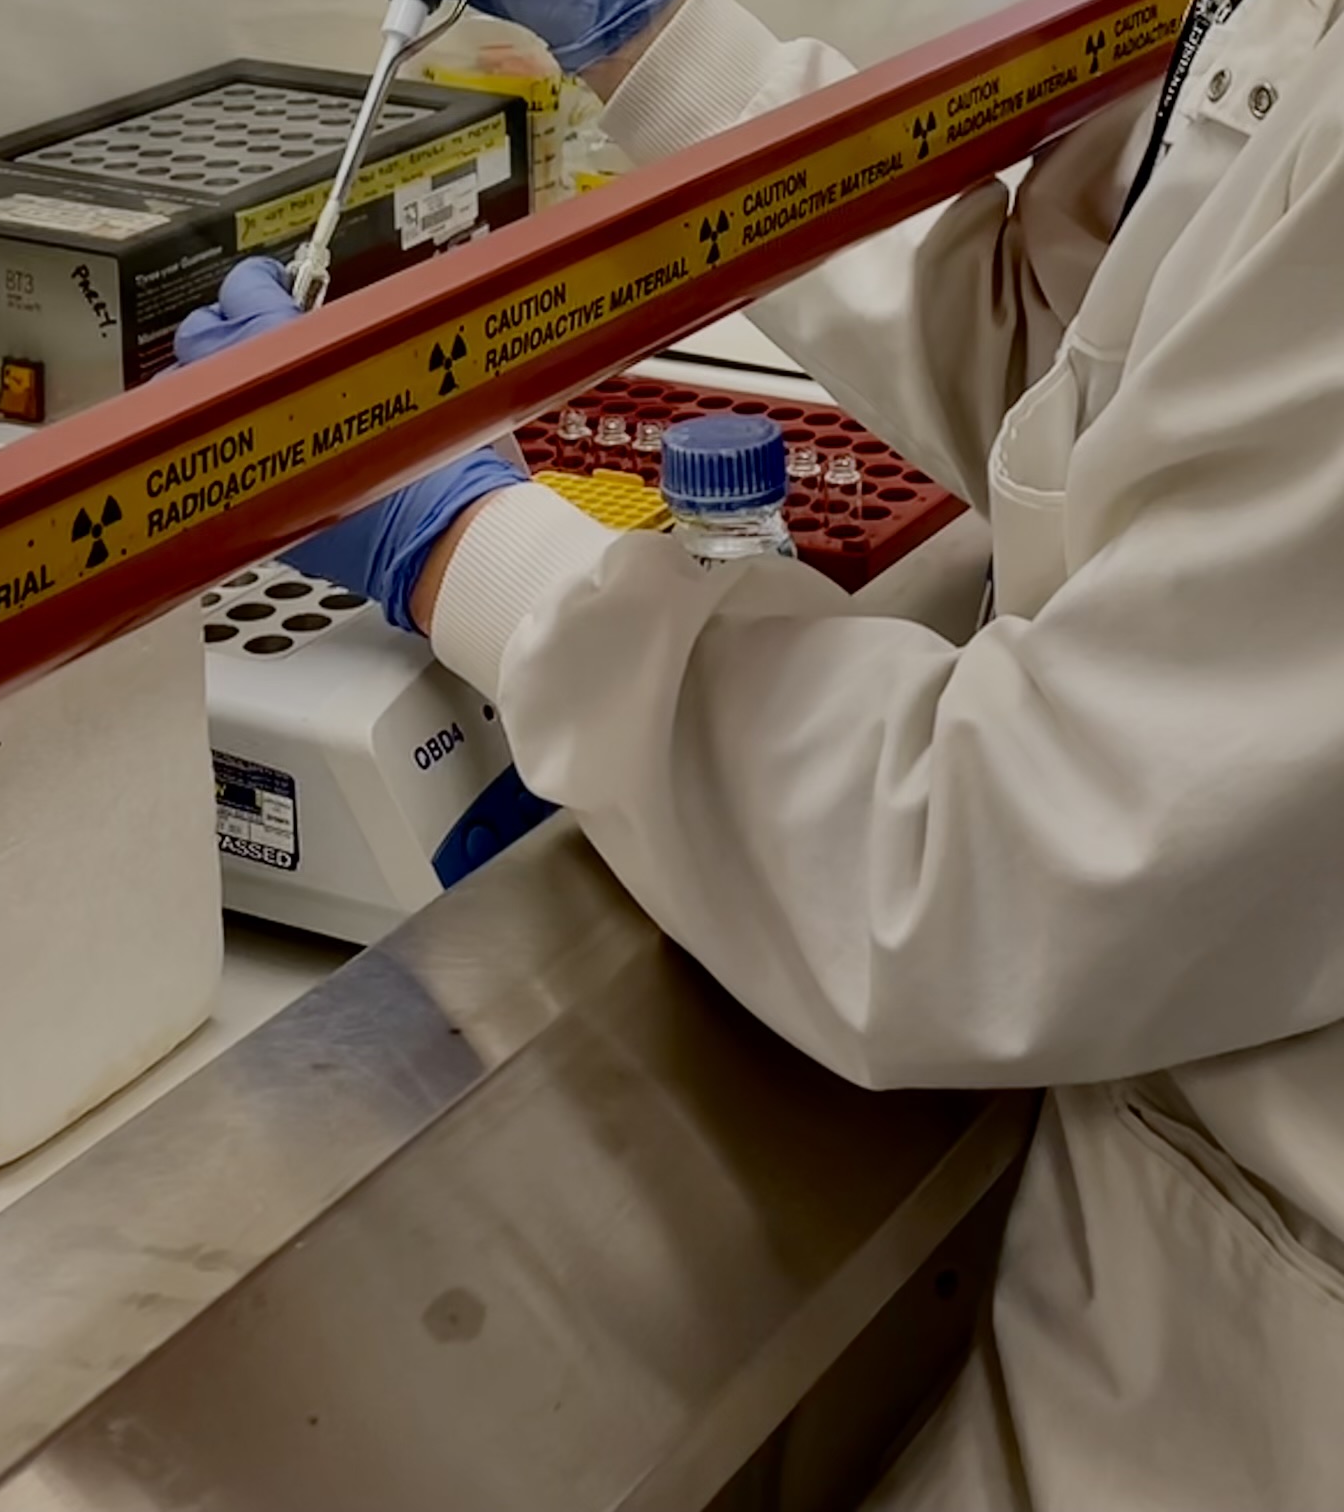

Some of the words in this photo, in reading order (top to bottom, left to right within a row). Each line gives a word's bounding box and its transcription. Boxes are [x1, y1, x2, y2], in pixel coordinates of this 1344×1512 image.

[1112, 19, 1179, 62] RADIOACTIVE
[1113, 3, 1159, 38] CAUTION
[946, 76, 1000, 118] CAUTION
[946, 91, 1024, 145] RADIOACTIVE
[1026, 66, 1078, 105] MATERIAL
[741, 183, 838, 247] RADIOACTIVE
[840, 151, 905, 199] MATERIAL
[742, 168, 808, 218] CAUTION
[5, 269, 35, 295] BT3
[484, 282, 567, 339] CAUTION
[484, 295, 605, 374] RADIOACTIVE
[609, 257, 690, 312] MATERIAL
[145, 426, 254, 499] CAUTION
[146, 438, 306, 538] RADIOACTIVE
[311, 389, 419, 459] MATERIAL
[414, 722, 465, 772] OBDA
